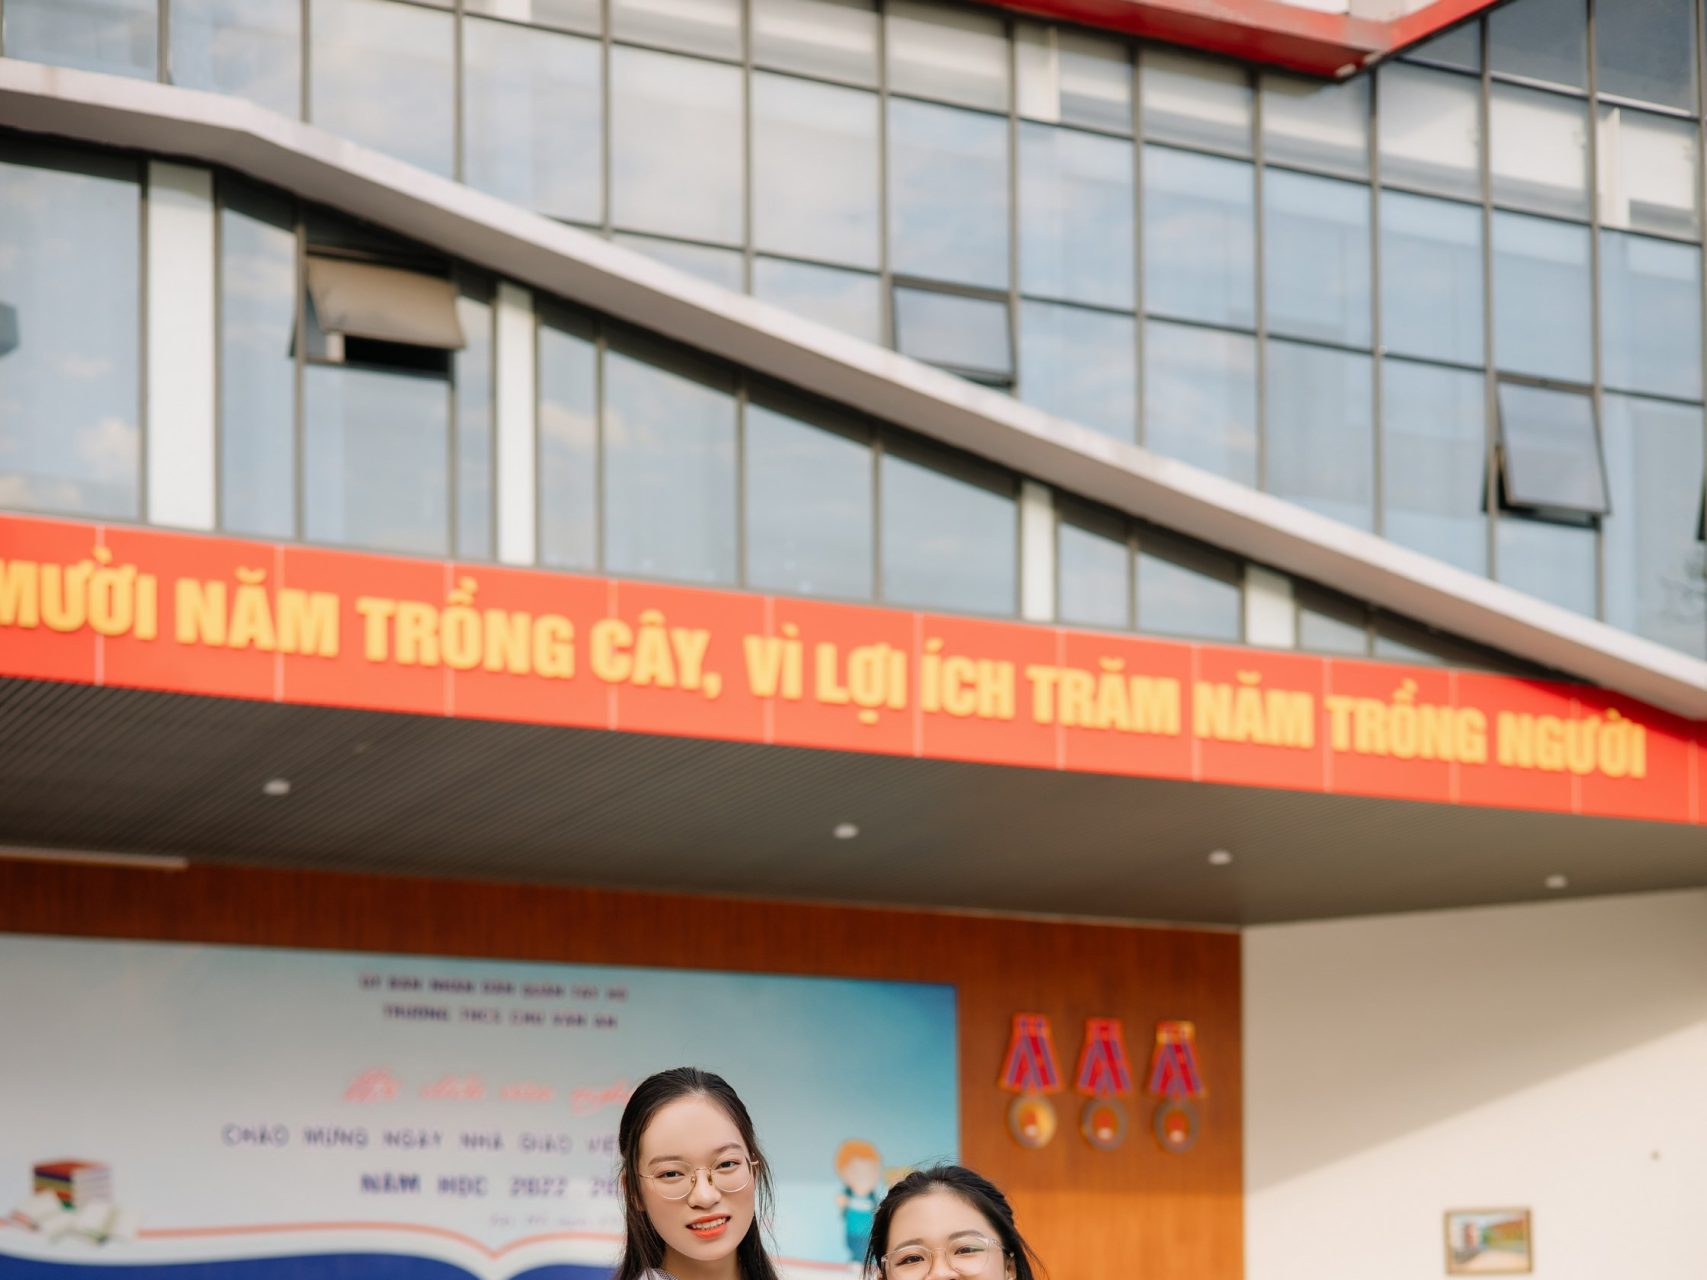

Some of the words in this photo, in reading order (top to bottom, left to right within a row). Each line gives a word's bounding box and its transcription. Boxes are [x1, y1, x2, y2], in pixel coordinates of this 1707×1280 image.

[175, 568, 339, 657] NĂM
[590, 610, 721, 698] CÂY,
[743, 624, 803, 699] VÌ
[815, 643, 907, 724] LỢI
[919, 638, 1015, 719] ÍCH
[1025, 658, 1180, 736] TRĂM
[1192, 672, 1314, 748] NĂM
[1497, 707, 1645, 777] NGƯỜI
